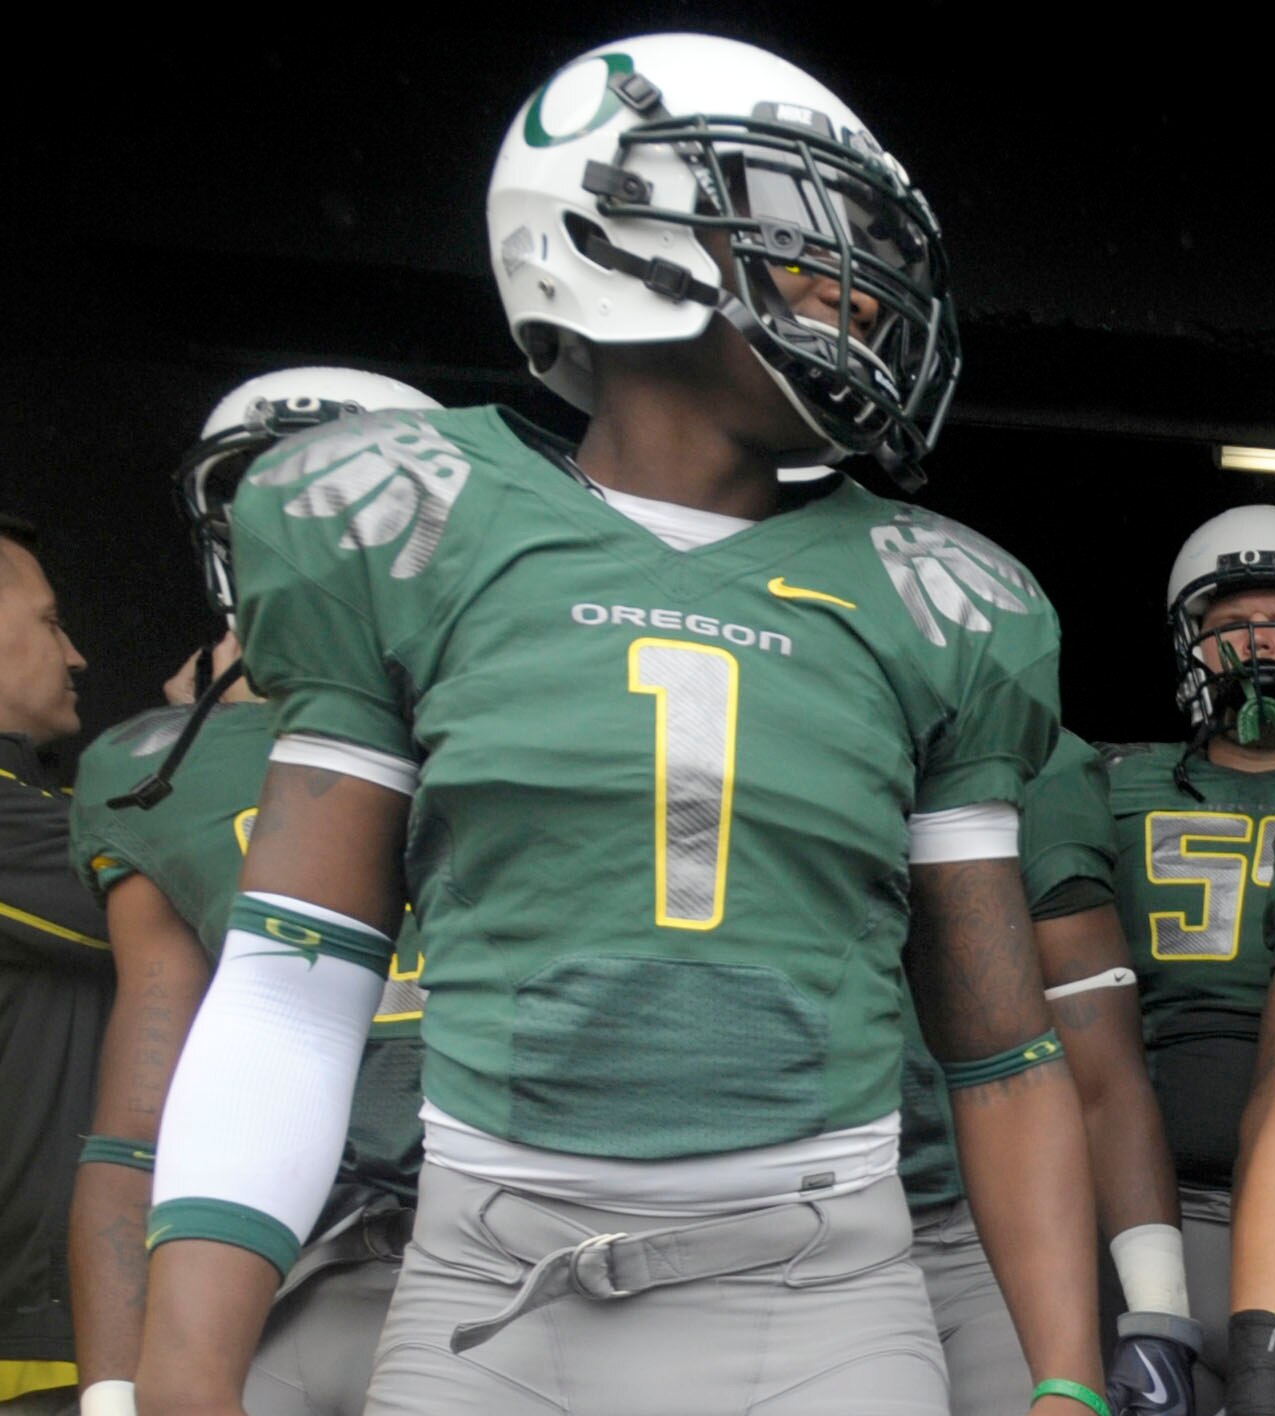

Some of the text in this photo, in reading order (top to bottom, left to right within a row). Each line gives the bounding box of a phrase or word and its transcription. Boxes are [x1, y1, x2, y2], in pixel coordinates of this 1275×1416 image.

[1239, 550, 1260, 565] O
[571, 603, 793, 655] OREGON
[627, 637, 740, 931] 1
